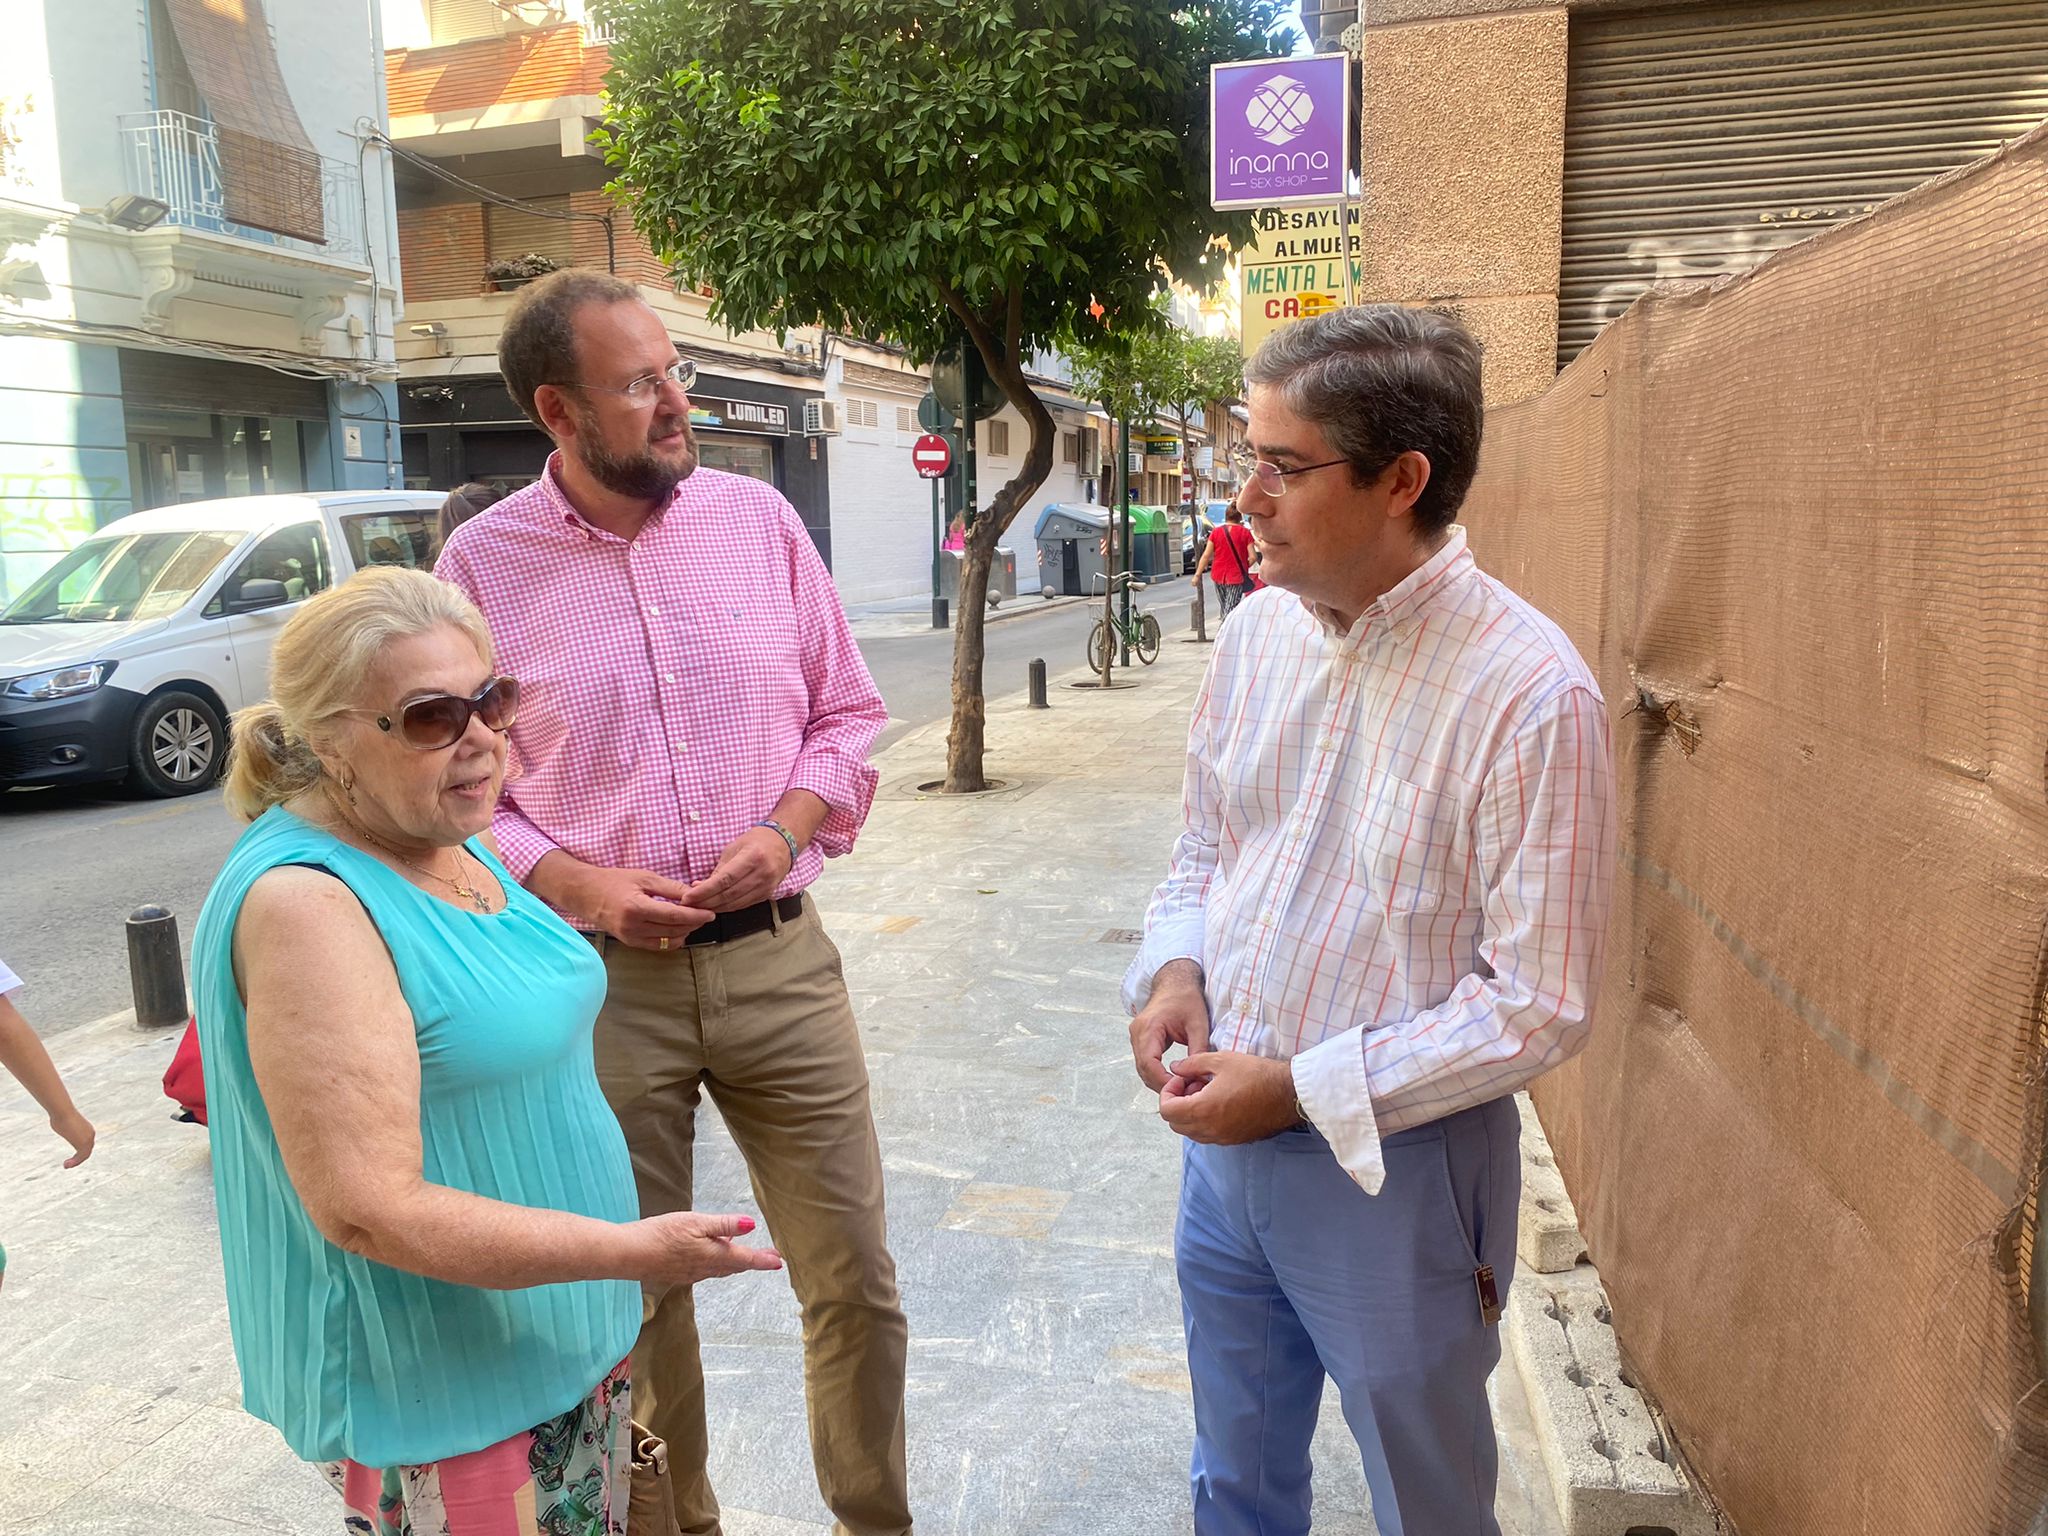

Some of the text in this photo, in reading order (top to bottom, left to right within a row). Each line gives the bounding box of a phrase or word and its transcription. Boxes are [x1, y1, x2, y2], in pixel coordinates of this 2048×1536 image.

[1230, 149, 1329, 175] inanna
[1250, 174, 1308, 189] SEX SHOP
[1247, 261, 1361, 295] MENTA LM
